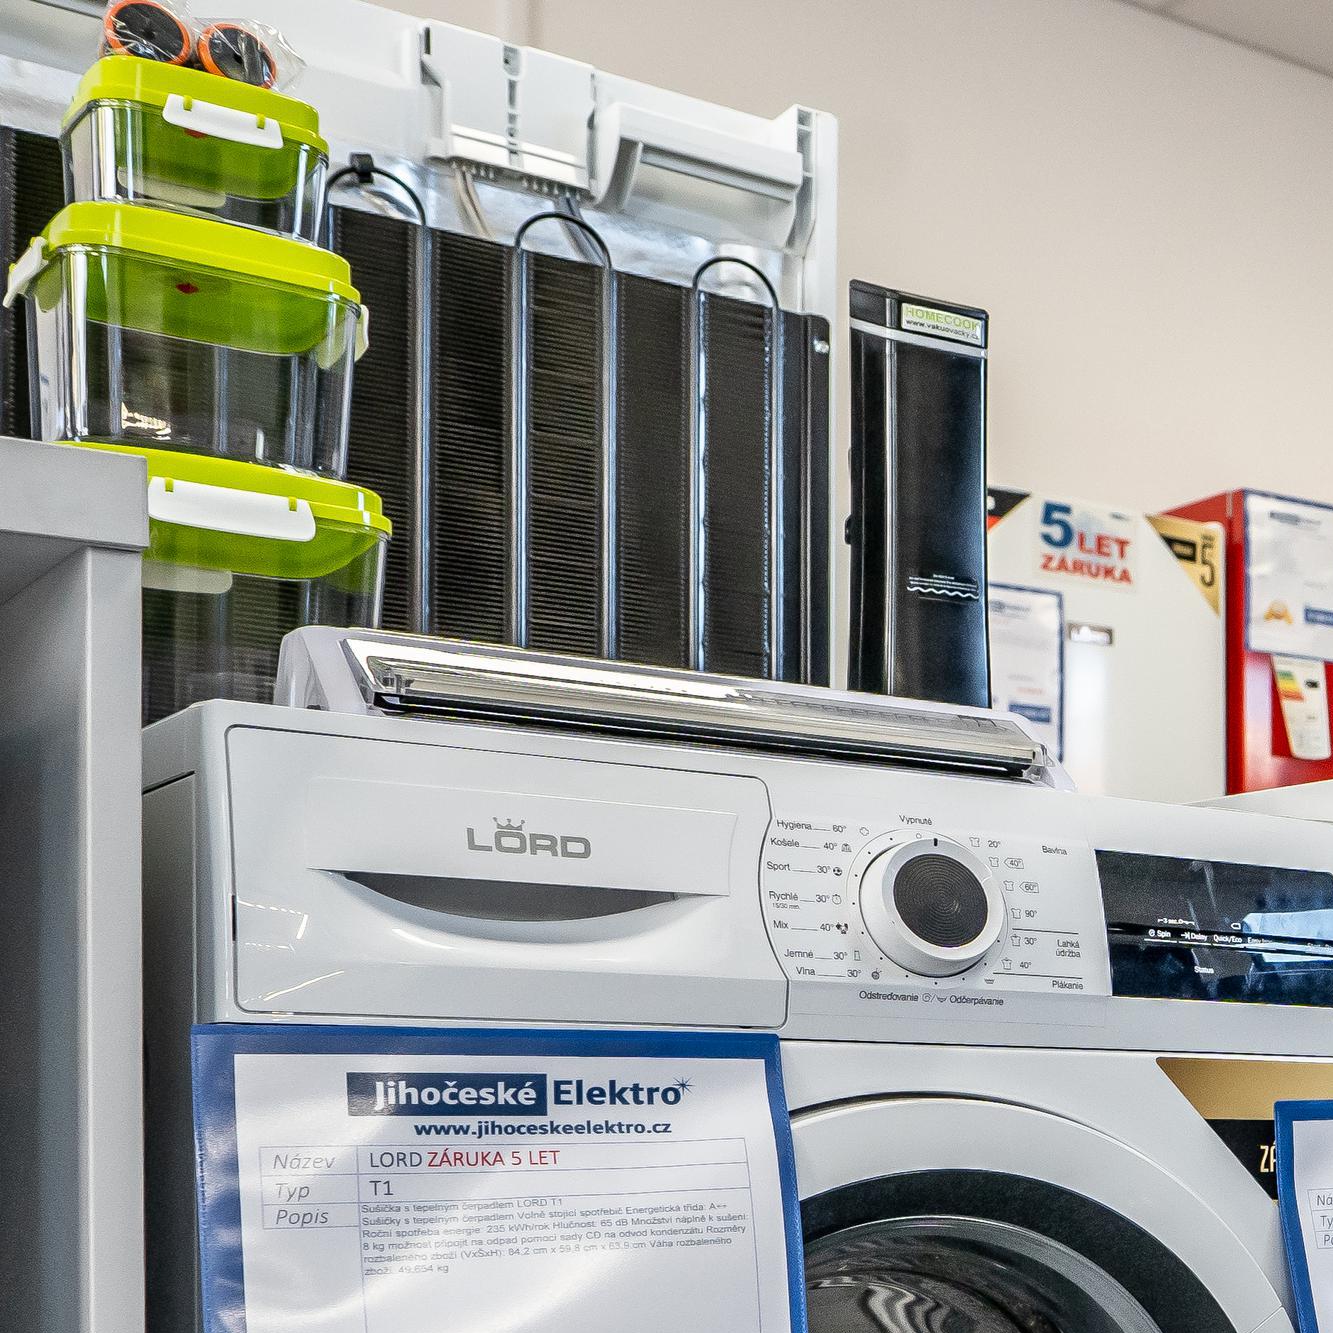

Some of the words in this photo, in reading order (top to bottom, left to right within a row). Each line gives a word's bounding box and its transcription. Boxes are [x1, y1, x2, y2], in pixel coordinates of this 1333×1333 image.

[1041, 500, 1074, 549] 5
[1077, 531, 1131, 560] LET
[1041, 552, 1133, 585] ZÁRUKA
[776, 819, 813, 831] Hygiena
[467, 827, 591, 859] LORD
[823, 843, 838, 851] 40°
[766, 861, 791, 871] Sport
[816, 865, 831, 874] 30°
[768, 890, 799, 902] Rychlé
[815, 894, 830, 903] 30°
[773, 920, 789, 929] Mix
[1190, 932, 1208, 941] Delay
[1213, 934, 1243, 943] Quick/Eco
[784, 949, 814, 959] Jemné
[796, 966, 816, 976] Vlna
[1194, 965, 1214, 974] Status
[373, 1079, 537, 1112] Jihočeské
[553, 1078, 682, 1106] Elektro
[414, 1119, 672, 1138] www.jihoceskeelektro.cz
[272, 1152, 336, 1170] Název
[370, 1151, 422, 1167] LORD
[427, 1148, 505, 1167] ZÁRUKA
[511, 1151, 522, 1165] 5
[529, 1150, 560, 1166] LET
[276, 1183, 310, 1202] Typ
[369, 1180, 394, 1196] T1
[361, 1204, 400, 1213] Sušička
[517, 1199, 548, 1208] LORD
[551, 1198, 562, 1206] T1
[275, 1209, 329, 1228] Popis
[615, 1217, 628, 1226] dB
[372, 1242, 385, 1252] kg
[486, 1236, 518, 1246] odpad
[560, 1232, 583, 1242] sady
[619, 1228, 647, 1238] odvod
